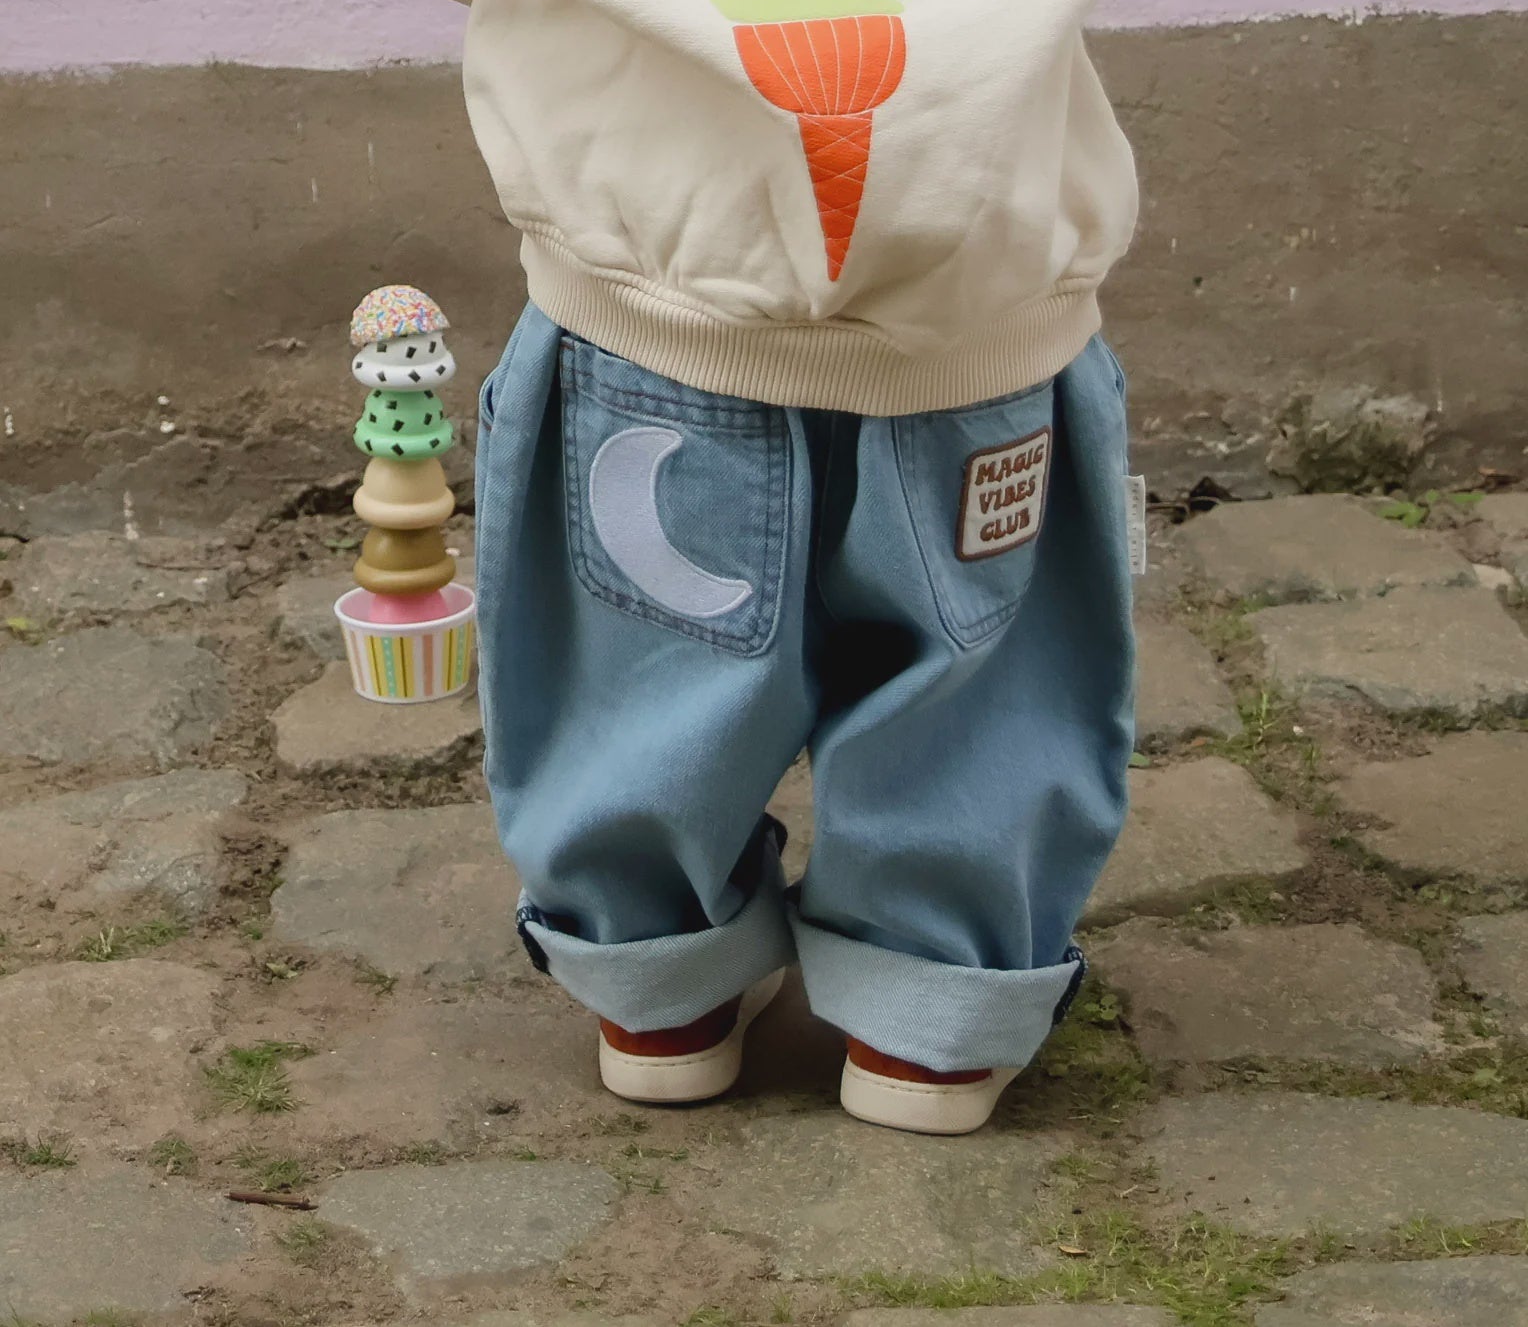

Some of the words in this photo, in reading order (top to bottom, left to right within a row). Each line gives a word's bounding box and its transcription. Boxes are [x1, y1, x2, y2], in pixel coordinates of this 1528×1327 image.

[974, 443, 1045, 486] MAGIC
[979, 474, 1037, 515] VIBES
[979, 507, 1031, 542] CLUB
